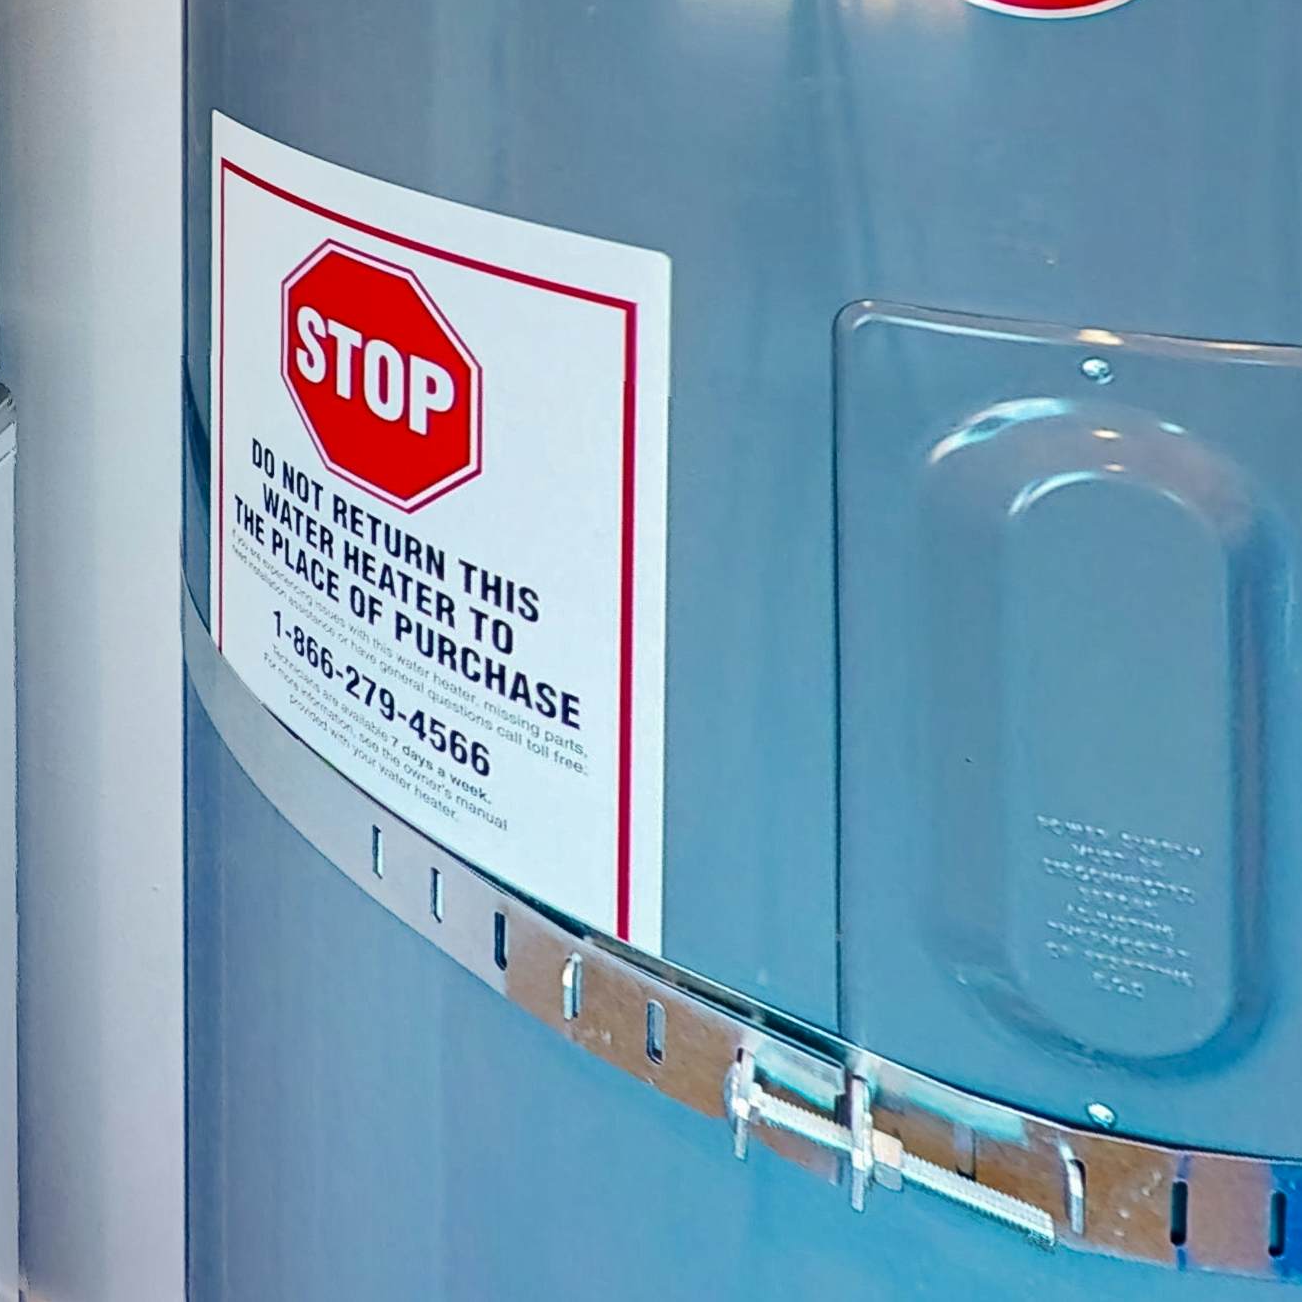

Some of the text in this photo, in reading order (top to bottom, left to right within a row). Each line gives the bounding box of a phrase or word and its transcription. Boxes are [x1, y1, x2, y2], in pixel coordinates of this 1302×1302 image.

[296, 305, 455, 436] STOP
[252, 438, 540, 623] DO NOT RETURN THIS
[263, 483, 513, 656] WATER HEATER TO
[234, 495, 581, 731] THE PLACE OF PURCHASE
[273, 610, 490, 777] 1-866-279-4566
[349, 622, 370, 644] with
[372, 637, 393, 658] this
[397, 655, 430, 679] water
[484, 700, 540, 738] missing
[351, 641, 376, 665] have
[379, 661, 424, 693] general
[427, 689, 494, 731] questions
[497, 725, 522, 746] call
[527, 738, 549, 759] toll
[329, 728, 351, 749] with
[353, 744, 378, 768] your
[378, 762, 413, 791] water
[358, 732, 380, 753] see
[382, 746, 401, 768] the
[403, 763, 453, 800] owner's
[455, 794, 508, 831] manual
[402, 744, 434, 771] days
[449, 773, 492, 805] week.
